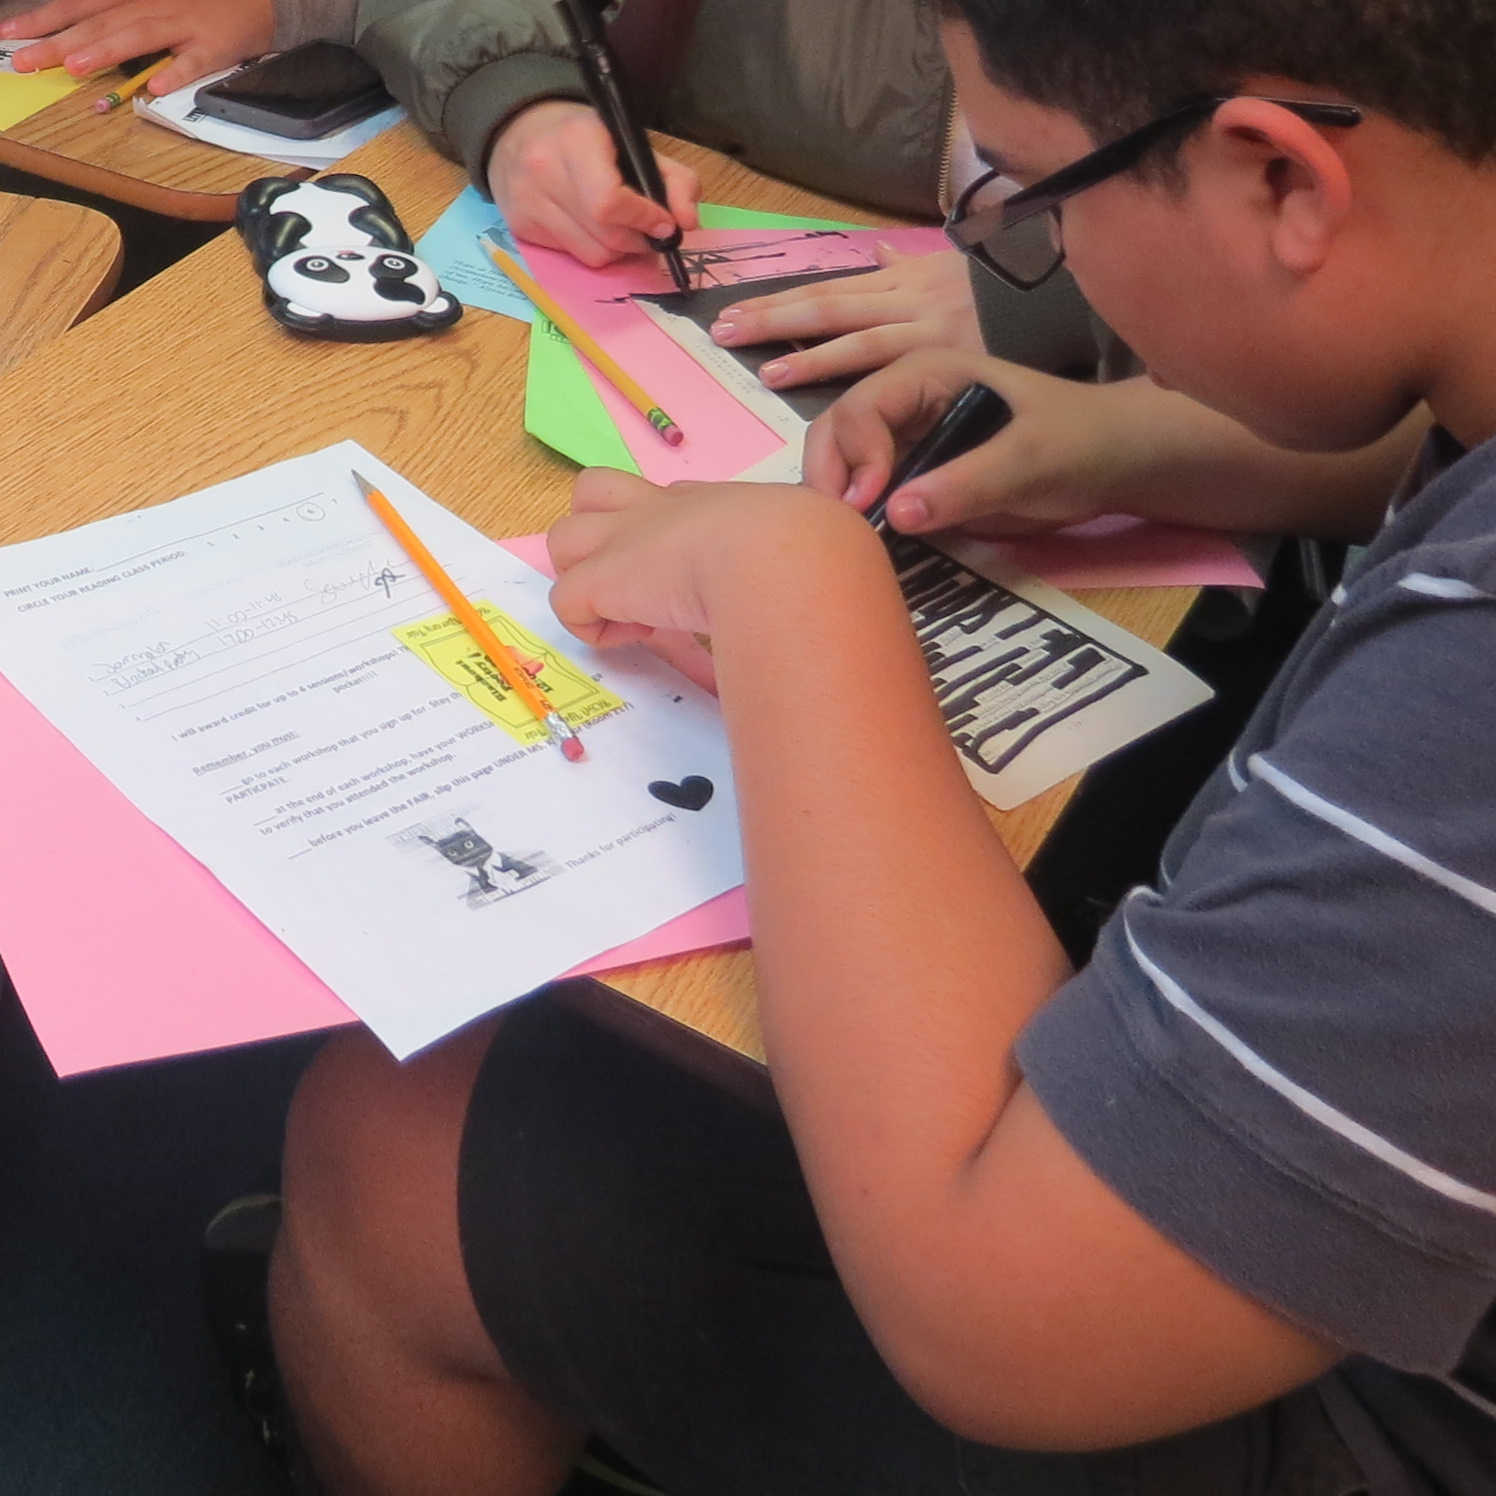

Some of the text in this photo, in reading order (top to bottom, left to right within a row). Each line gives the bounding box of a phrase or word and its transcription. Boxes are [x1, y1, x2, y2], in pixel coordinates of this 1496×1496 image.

[2, 566, 95, 597] PRINT YOUR NAME:
[16, 597, 50, 613] CIRCLE
[49, 589, 79, 602] YOUR
[78, 574, 122, 593] READING
[120, 563, 151, 578] CLASS
[149, 550, 186, 567] PERIOD:
[456, 657, 507, 702] Blackout
[177, 727, 197, 739] will
[197, 716, 229, 733] award
[229, 705, 258, 721] credit
[255, 700, 272, 709] for
[272, 694, 287, 703] up
[285, 689, 299, 698] to
[253, 771, 267, 779] to
[267, 760, 292, 774] each
[291, 743, 338, 764] workshop
[337, 734, 360, 747] that
[358, 727, 379, 739] you
[378, 718, 399, 731] sign
[398, 713, 413, 722] up
[428, 696, 451, 708] Stay
[192, 750, 253, 776] Remember,
[250, 741, 272, 754] you
[274, 805, 287, 814] at
[285, 799, 305, 809] the
[305, 790, 325, 803] end
[325, 786, 337, 795] of
[337, 777, 360, 791] each
[360, 758, 412, 781] workshop,
[408, 746, 435, 760] have
[433, 736, 457, 751] your
[259, 753, 456, 836] to verify that you attended the workshop.
[307, 830, 344, 847] before
[343, 822, 364, 835] you
[361, 810, 390, 826] leave
[388, 803, 408, 814] the
[406, 791, 435, 807] FAIR,
[433, 783, 452, 795] slip
[450, 775, 471, 787] this
[470, 764, 494, 780] page
[492, 749, 527, 767] UNDER
[564, 849, 601, 869] Thanks
[598, 841, 615, 853] for
